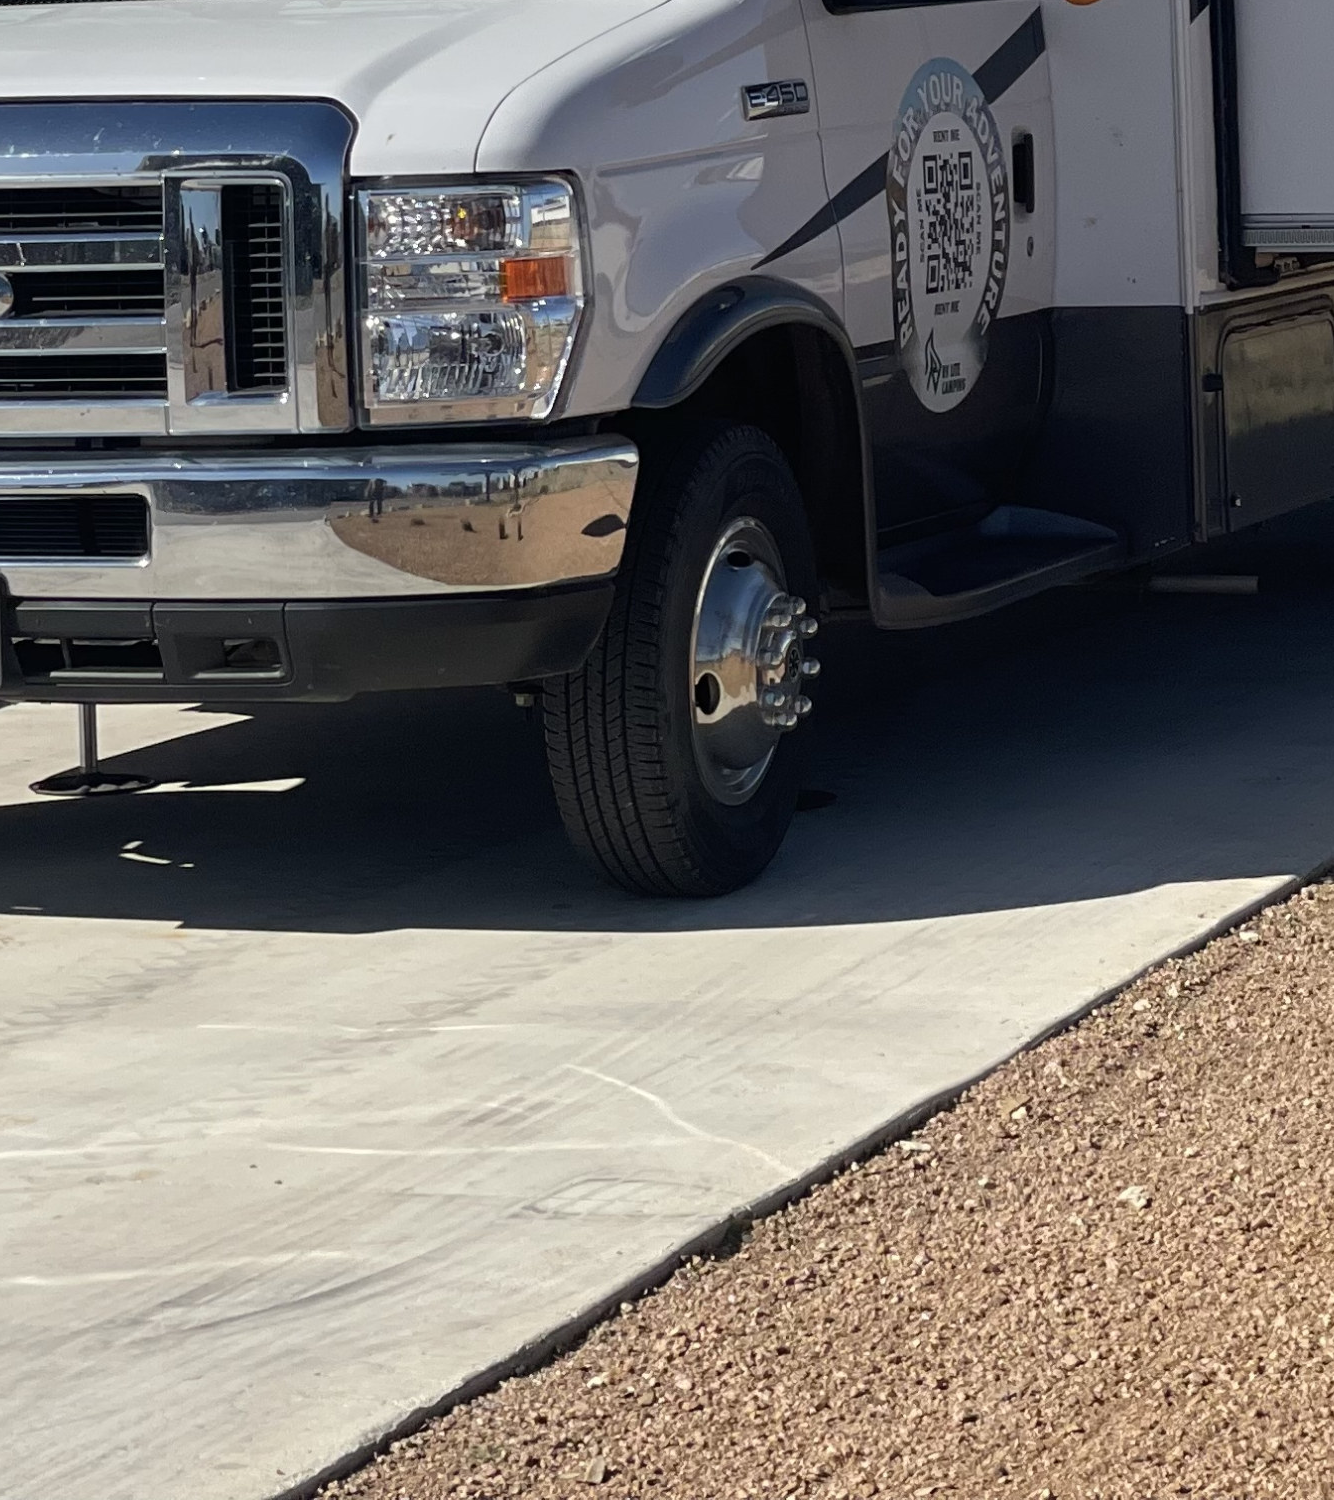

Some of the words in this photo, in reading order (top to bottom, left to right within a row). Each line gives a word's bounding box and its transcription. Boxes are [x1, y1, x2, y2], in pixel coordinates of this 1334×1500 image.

[892, 106, 919, 188] FOR
[917, 72, 964, 113] YOUR
[891, 199, 914, 349] READY
[966, 96, 1007, 336] ADVENTURE
